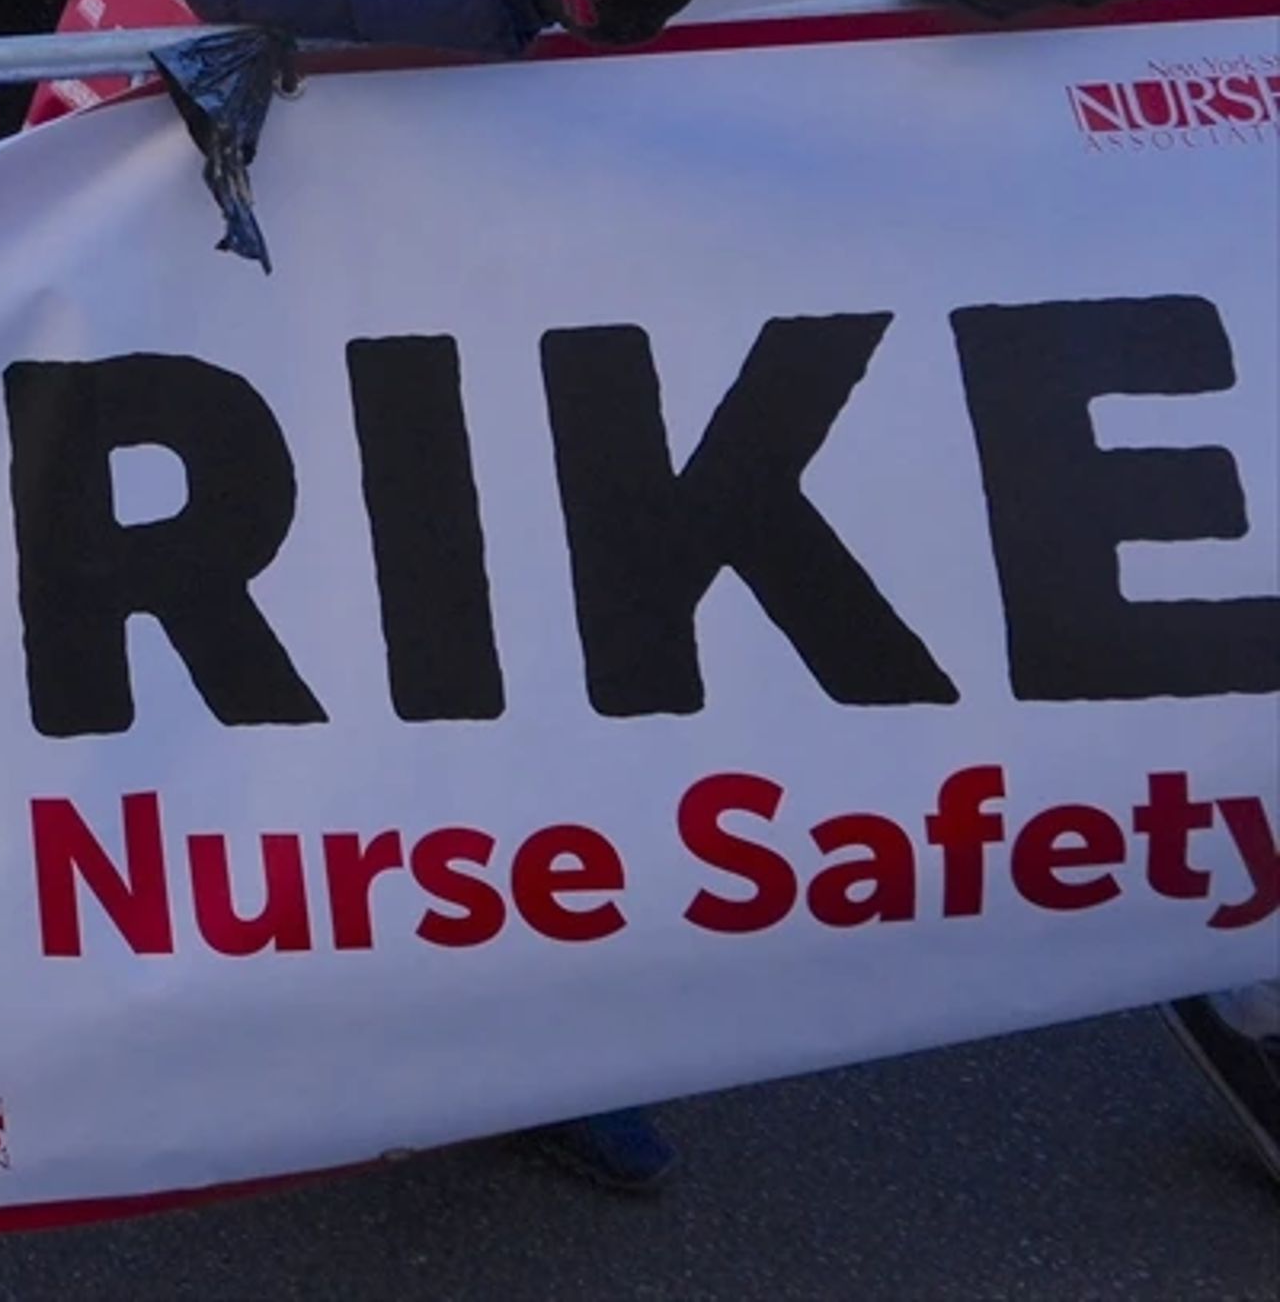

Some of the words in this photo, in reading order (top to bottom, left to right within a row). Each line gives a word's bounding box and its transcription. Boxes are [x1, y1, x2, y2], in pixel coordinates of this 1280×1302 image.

[1065, 75, 1280, 134] NURSE
[1085, 123, 1268, 151] ASSOCIAT
[29, 791, 628, 958] Nurse
[676, 763, 1280, 935] Safety
